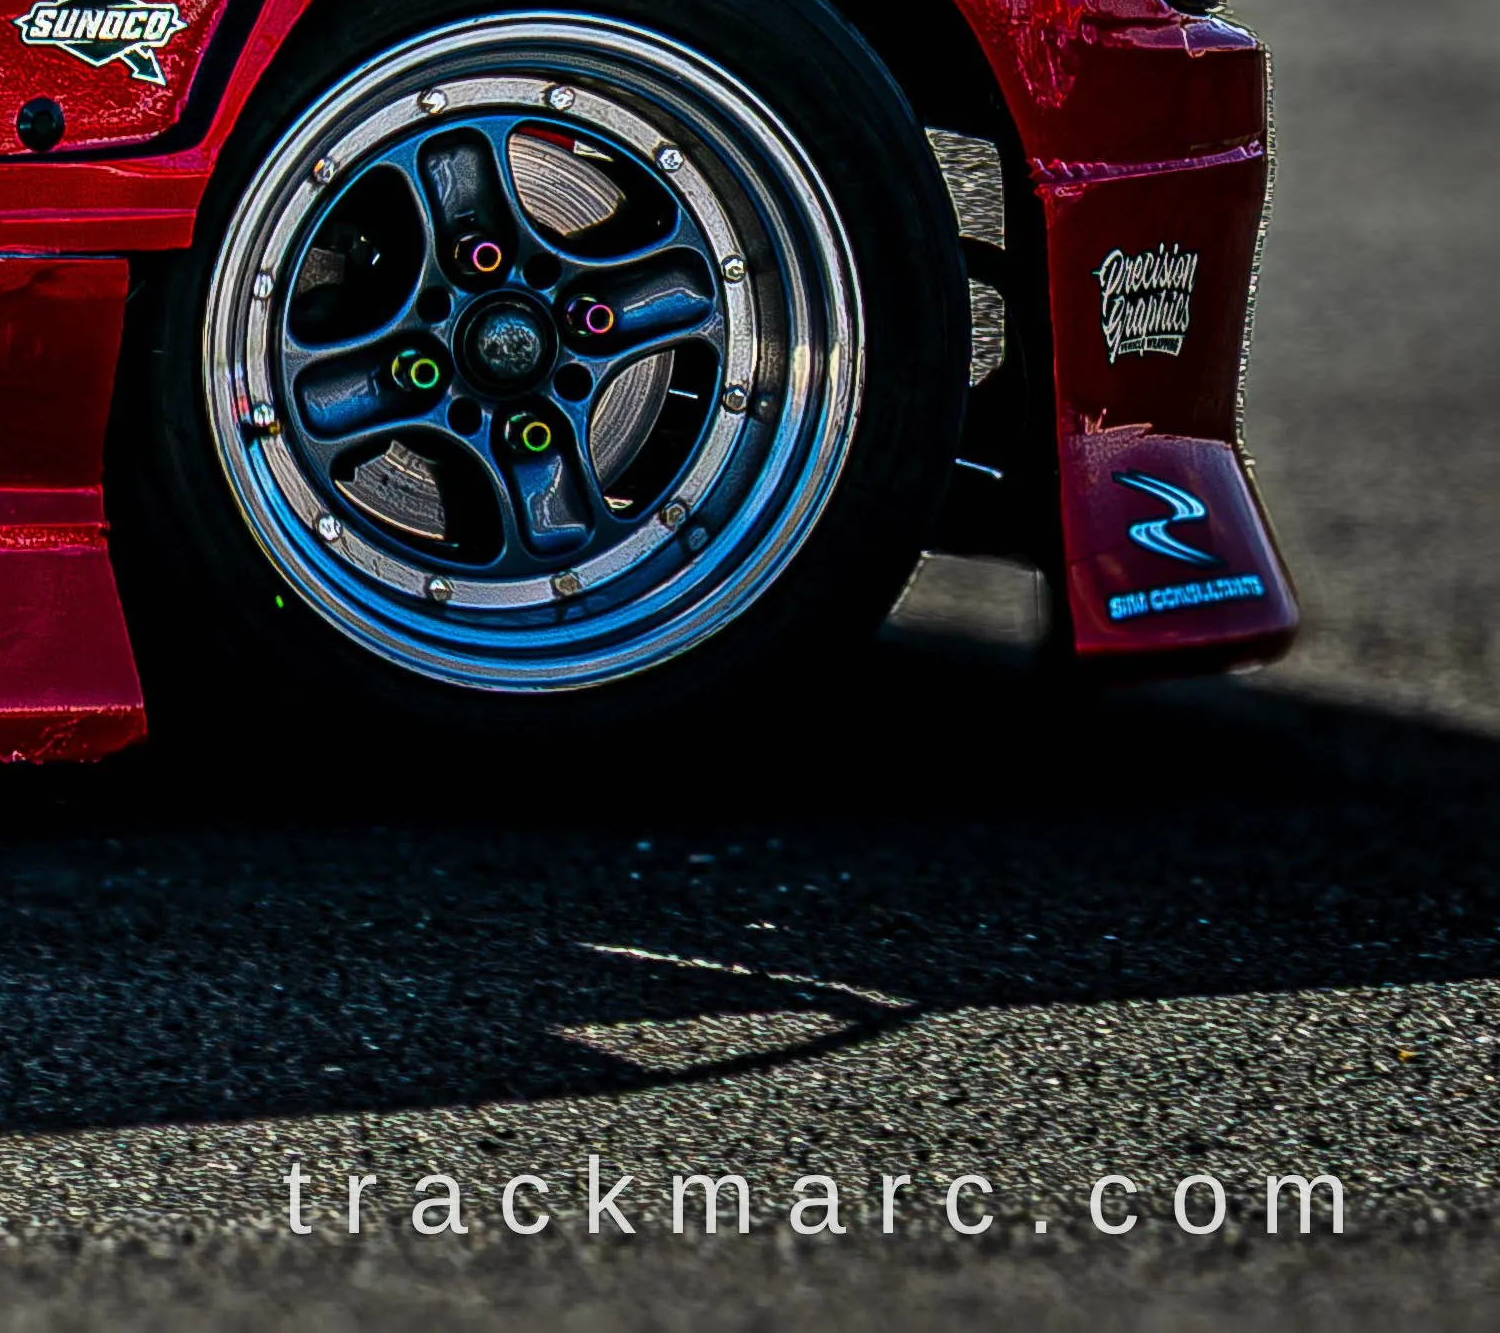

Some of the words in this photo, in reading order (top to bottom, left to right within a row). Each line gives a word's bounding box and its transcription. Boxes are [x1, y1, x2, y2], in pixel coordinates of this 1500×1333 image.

[28, 7, 171, 44] SUNOCO
[1100, 242, 1199, 317] Precision
[1102, 290, 1190, 364] Graphics
